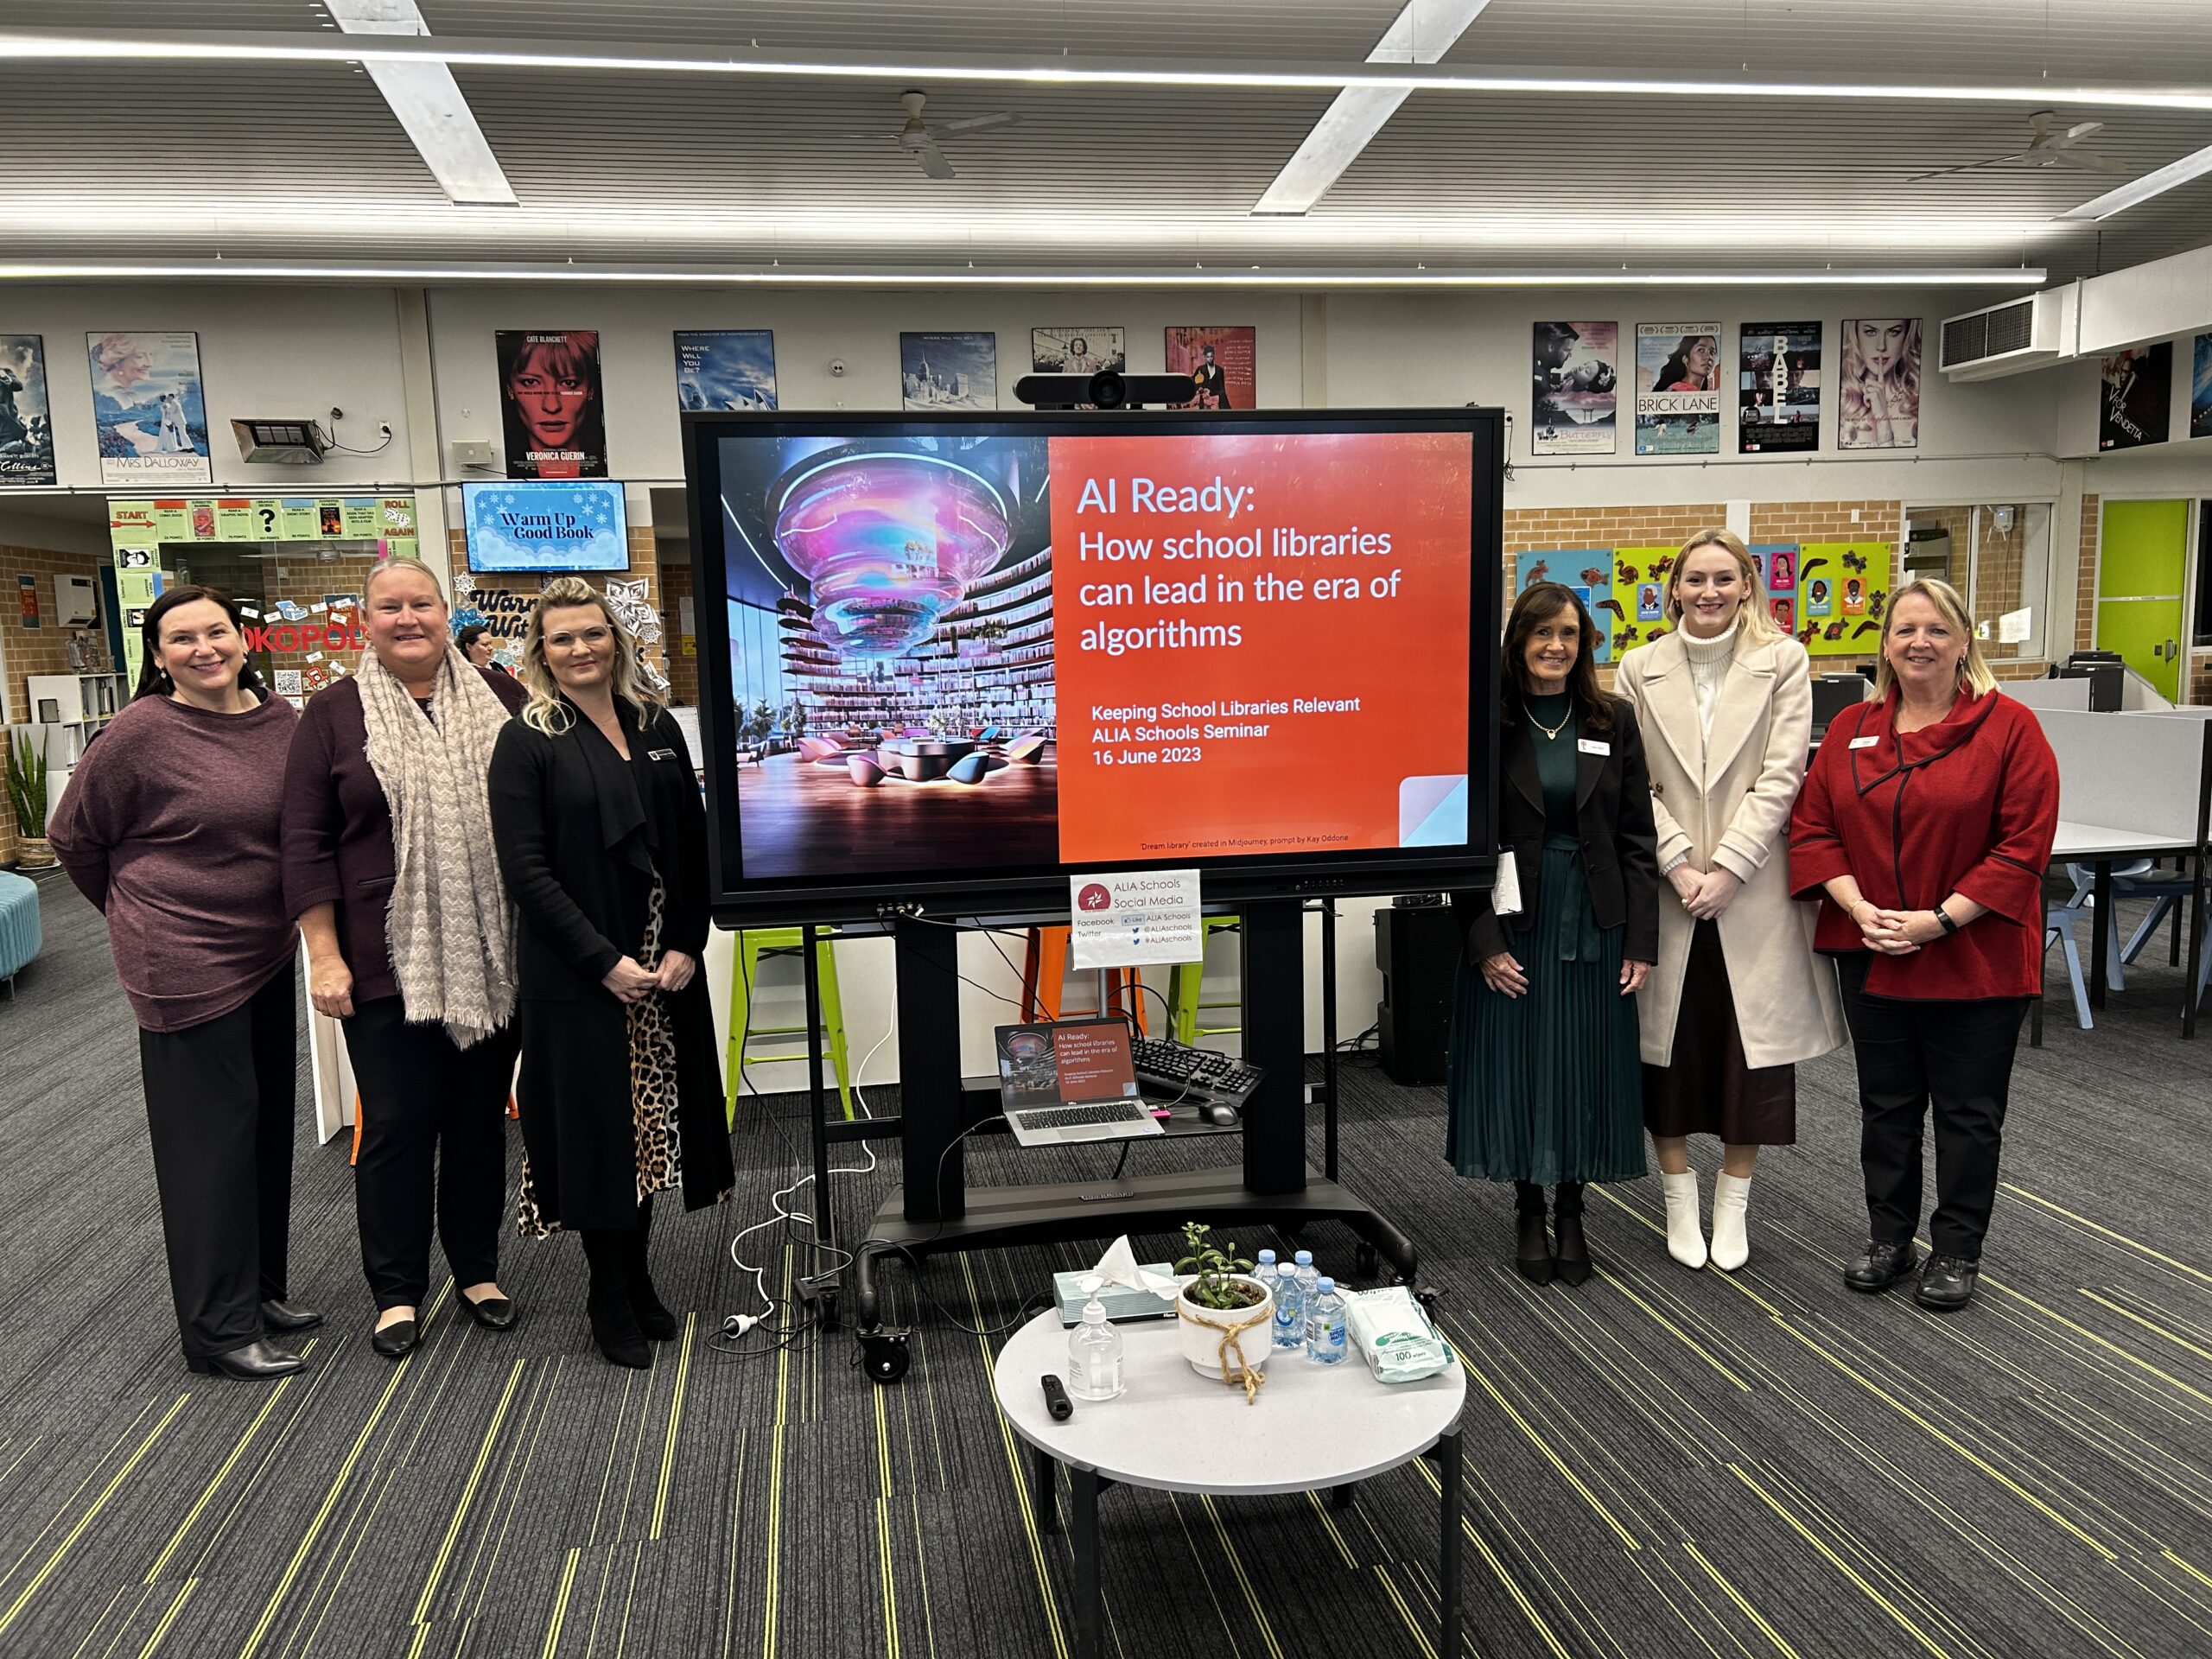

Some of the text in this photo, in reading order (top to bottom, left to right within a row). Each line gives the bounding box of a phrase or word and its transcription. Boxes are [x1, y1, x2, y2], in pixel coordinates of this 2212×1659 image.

[1772, 335, 1789, 424] BABEL
[1638, 397, 1718, 412] BRICK LANE
[2113, 396, 2126, 412] FOR
[2110, 405, 2142, 442] VENDETTA
[1560, 429, 1612, 440] BUTTERFLY
[117, 456, 200, 467] MRS. DALLOWAY
[525, 451, 585, 461] VERONICA GUERIN
[0, 461, 41, 472] Collins
[1077, 476, 1255, 518] AI Ready:
[116, 511, 149, 520] START
[258, 509, 276, 533] ?
[500, 512, 576, 528] Warm Up
[384, 528, 415, 537] AGAIN
[514, 524, 594, 539] Good Book
[1079, 526, 1392, 562] How school libraries
[1079, 569, 1402, 607] can lead in the era of
[1080, 619, 1243, 657] algorithms
[1091, 696, 1361, 723] Keeping School Libraries Relevant
[1091, 722, 1270, 744] ALIA Schools Seminar
[1092, 746, 1202, 766] 16 June 2023
[1192, 840, 1219, 849] created
[1270, 836, 1296, 847] prompt
[1297, 836, 1306, 845] by
[1306, 835, 1320, 844] Kay
[1321, 834, 1349, 842] Oddone
[1114, 880, 1181, 893] ALIA Schools
[1115, 895, 1184, 909] Social Media
[1077, 918, 1115, 927] Facebook
[1144, 924, 1192, 932] @ALIAschools
[1145, 935, 1192, 944] #ALIAschools
[1395, 1351, 1412, 1362] 100
